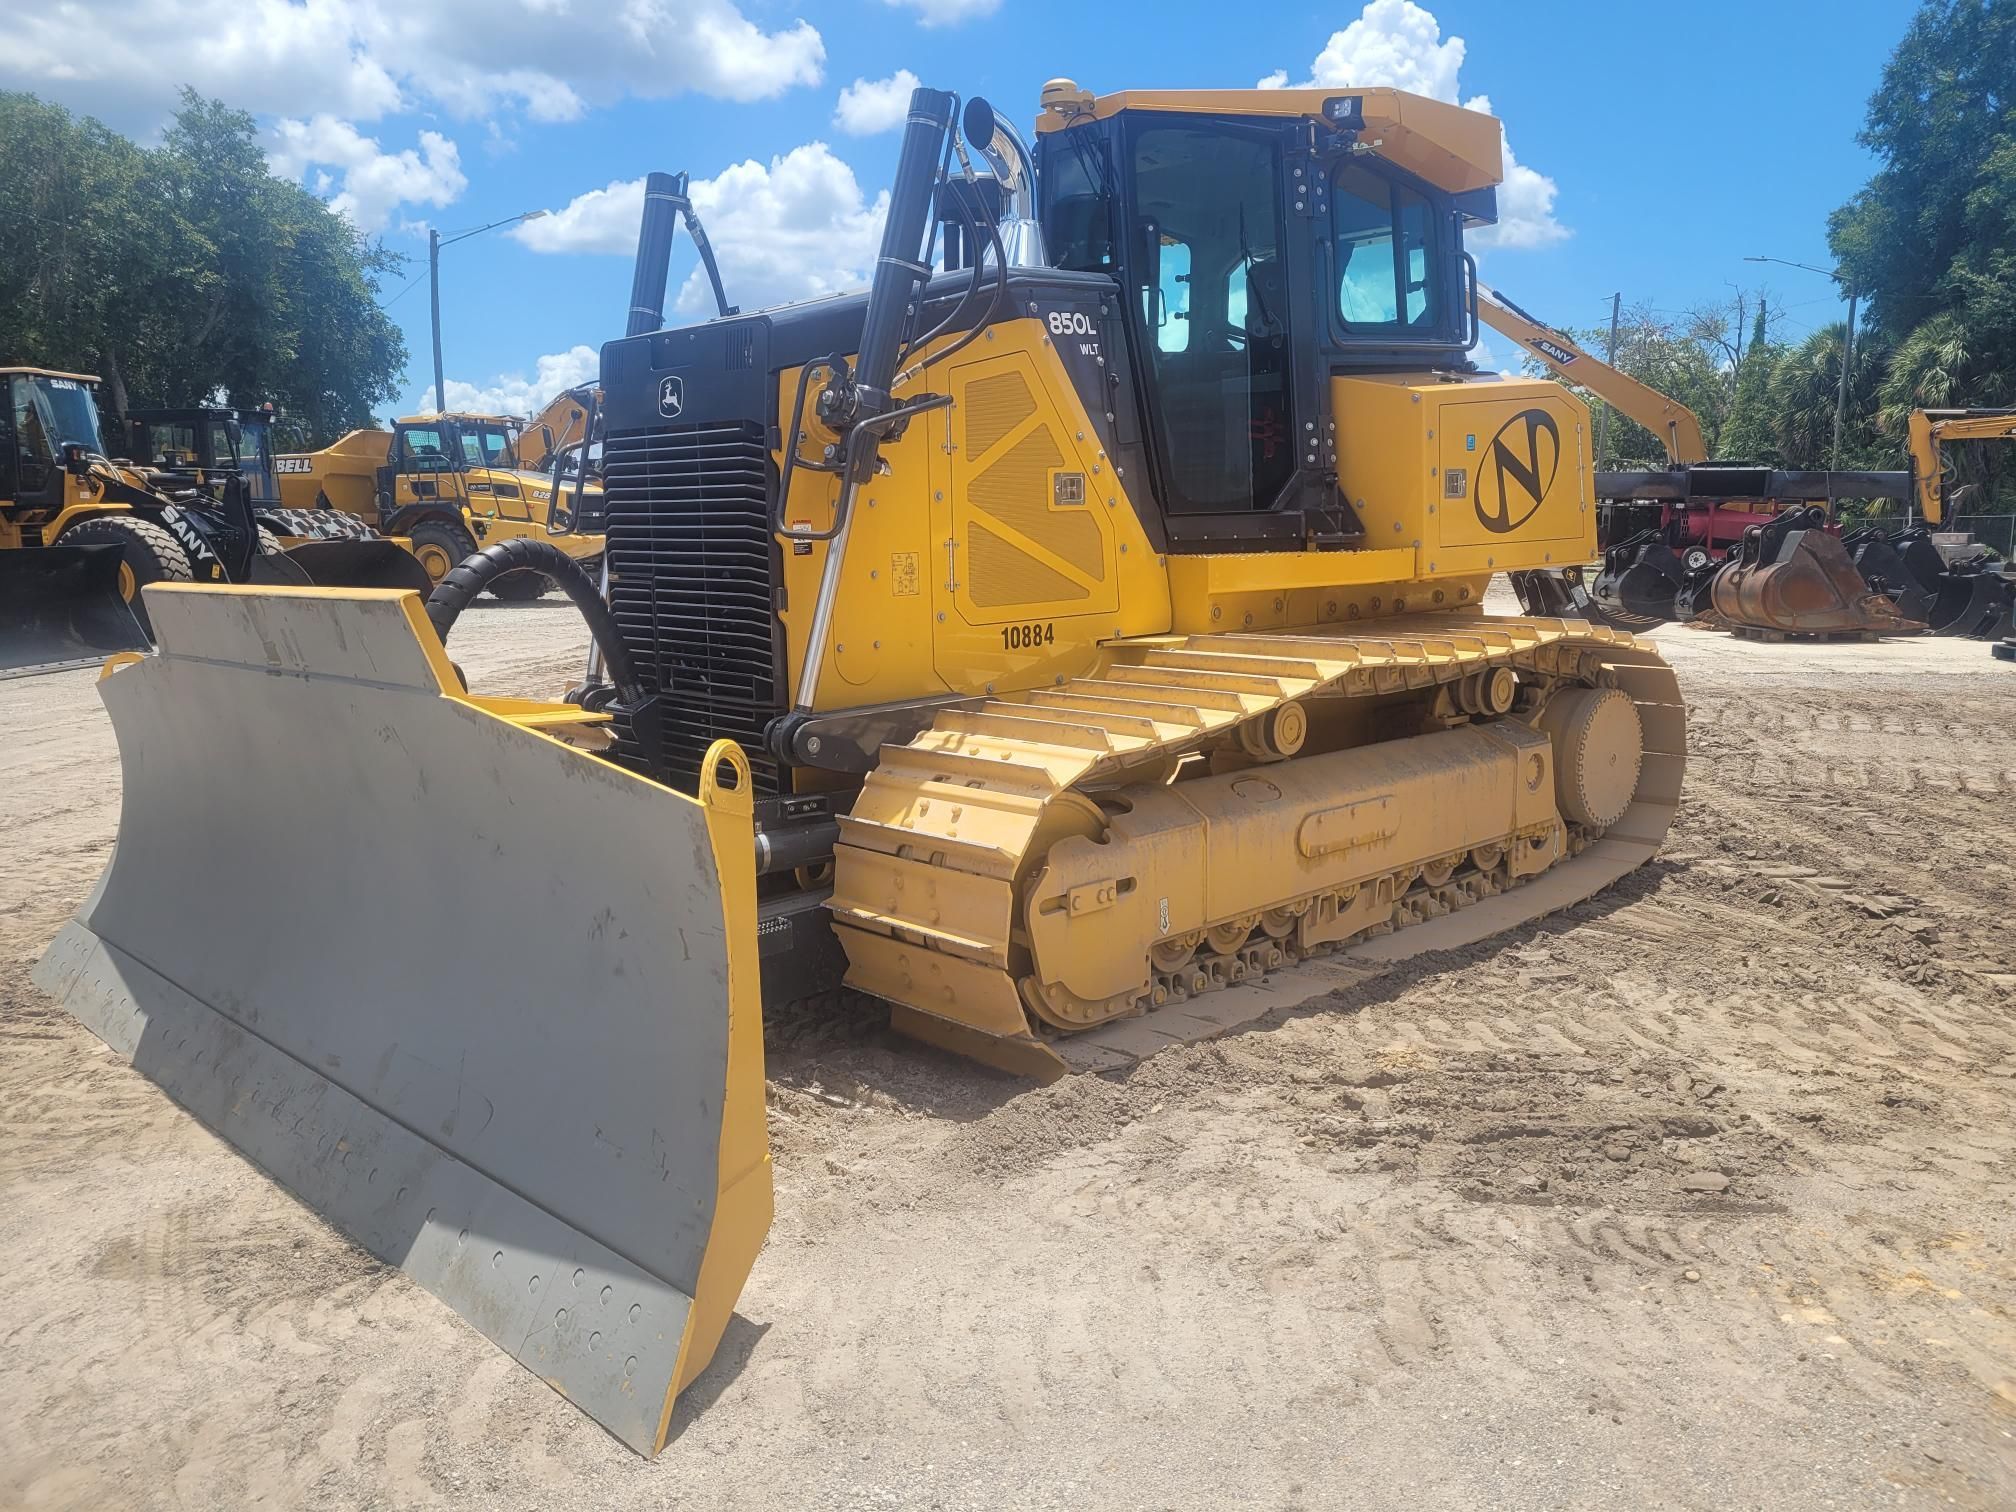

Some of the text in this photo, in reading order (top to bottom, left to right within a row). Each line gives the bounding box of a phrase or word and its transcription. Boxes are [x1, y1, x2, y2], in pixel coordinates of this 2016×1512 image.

[1048, 311, 1097, 335] 850L
[1079, 343, 1099, 355] WLT
[1540, 341, 1571, 362] SANY
[50, 379, 77, 391] SANY
[274, 458, 312, 473] BELL
[160, 505, 214, 560] SANY
[1001, 622, 1055, 650] 10884
